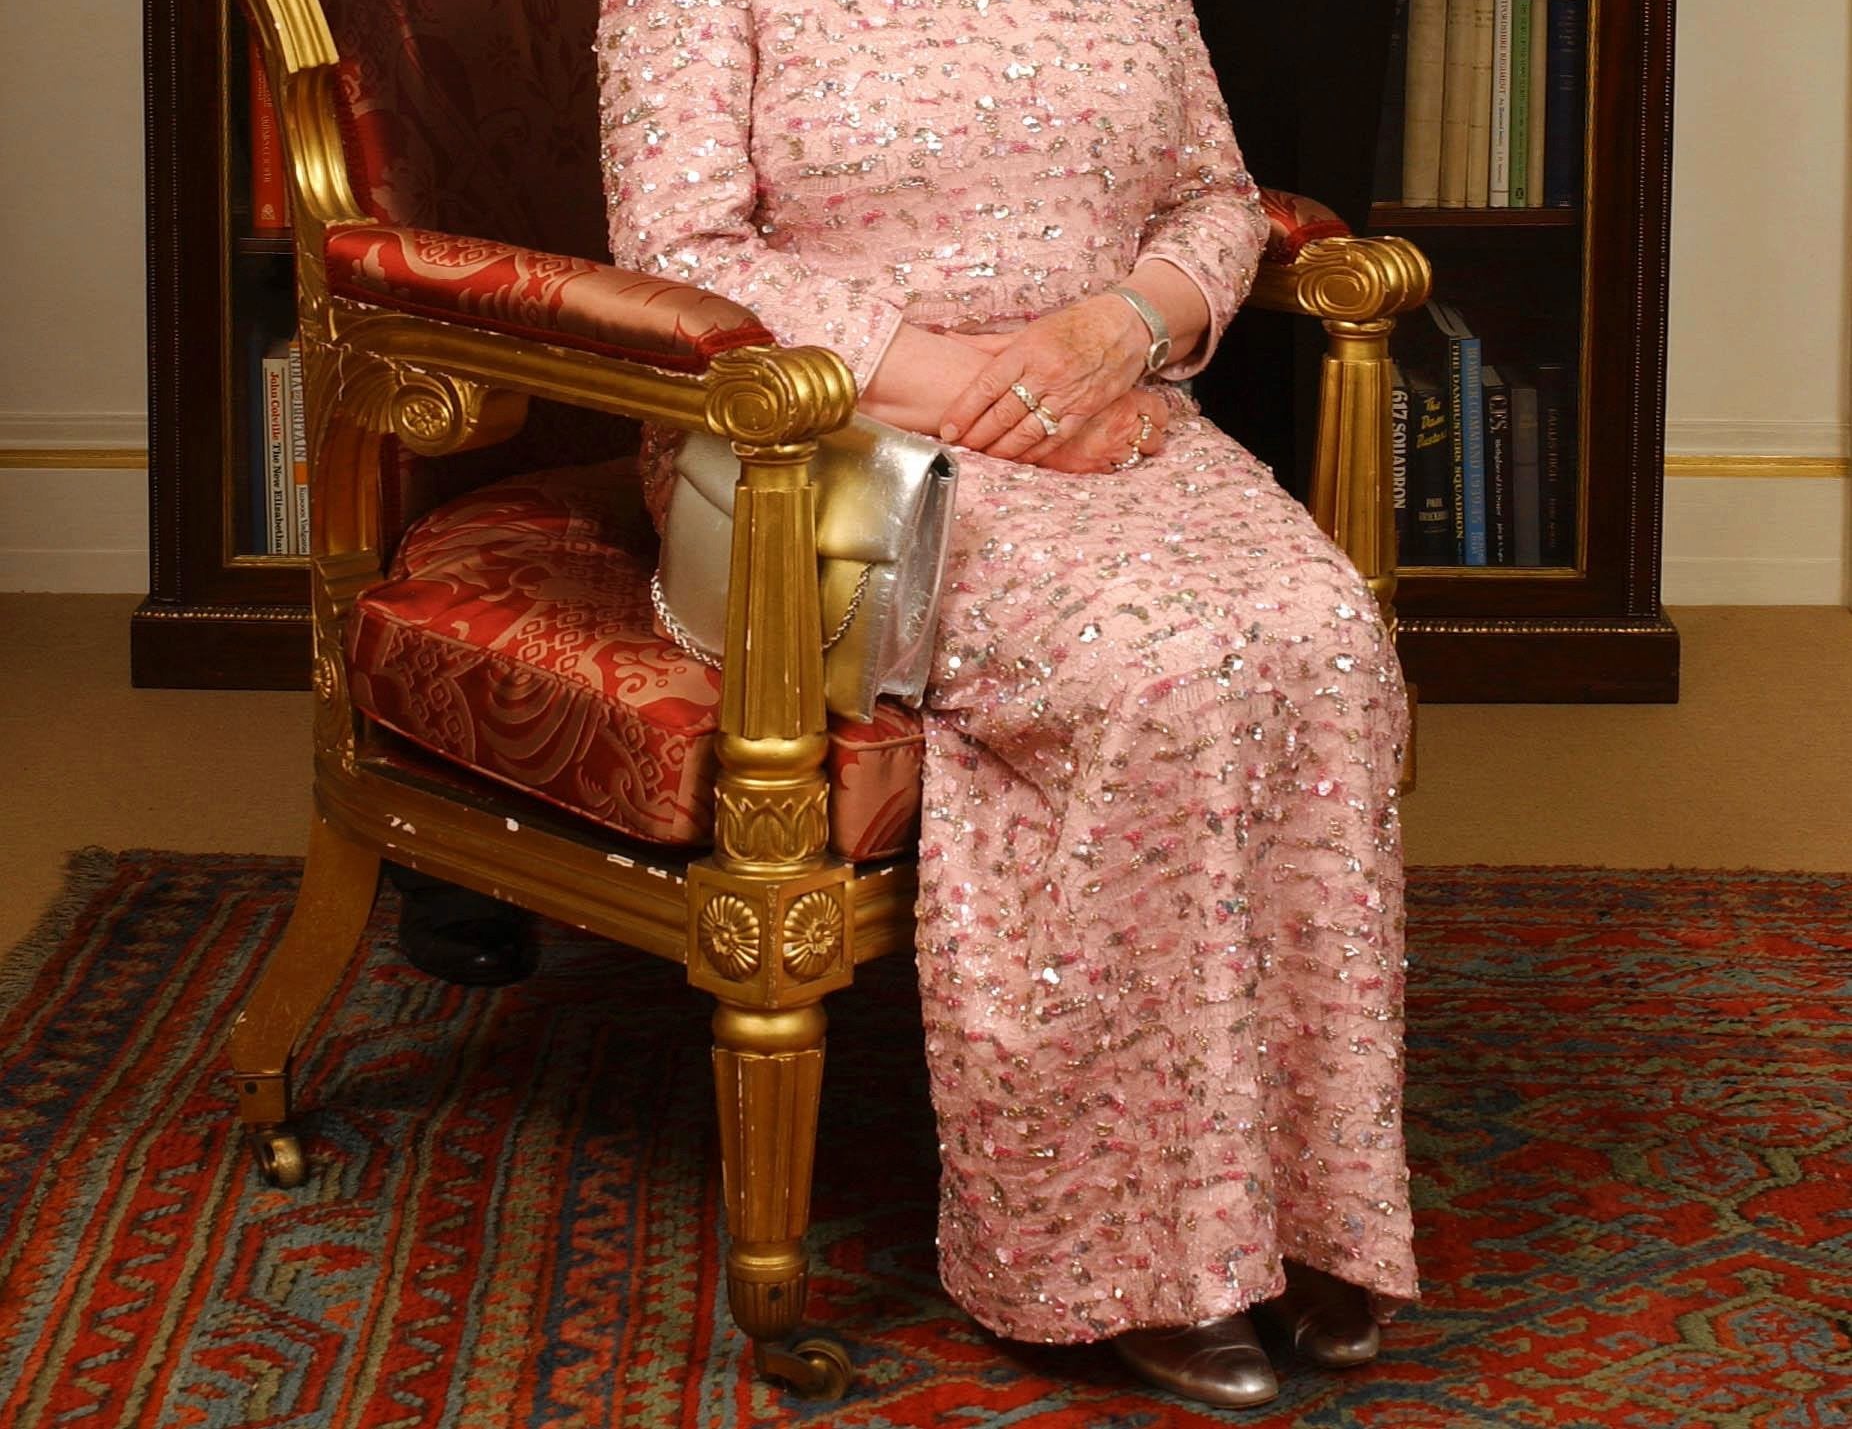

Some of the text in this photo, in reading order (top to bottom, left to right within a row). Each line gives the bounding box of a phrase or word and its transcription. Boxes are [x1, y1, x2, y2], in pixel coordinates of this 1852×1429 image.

[271, 371, 281, 398] John
[271, 399, 281, 440] Colville
[273, 443, 282, 464] The
[1391, 389, 1409, 510] 617 SQUADRON
[1451, 344, 1465, 540] THE DAMBUSTERS SQUADRON
[273, 466, 282, 488] New
